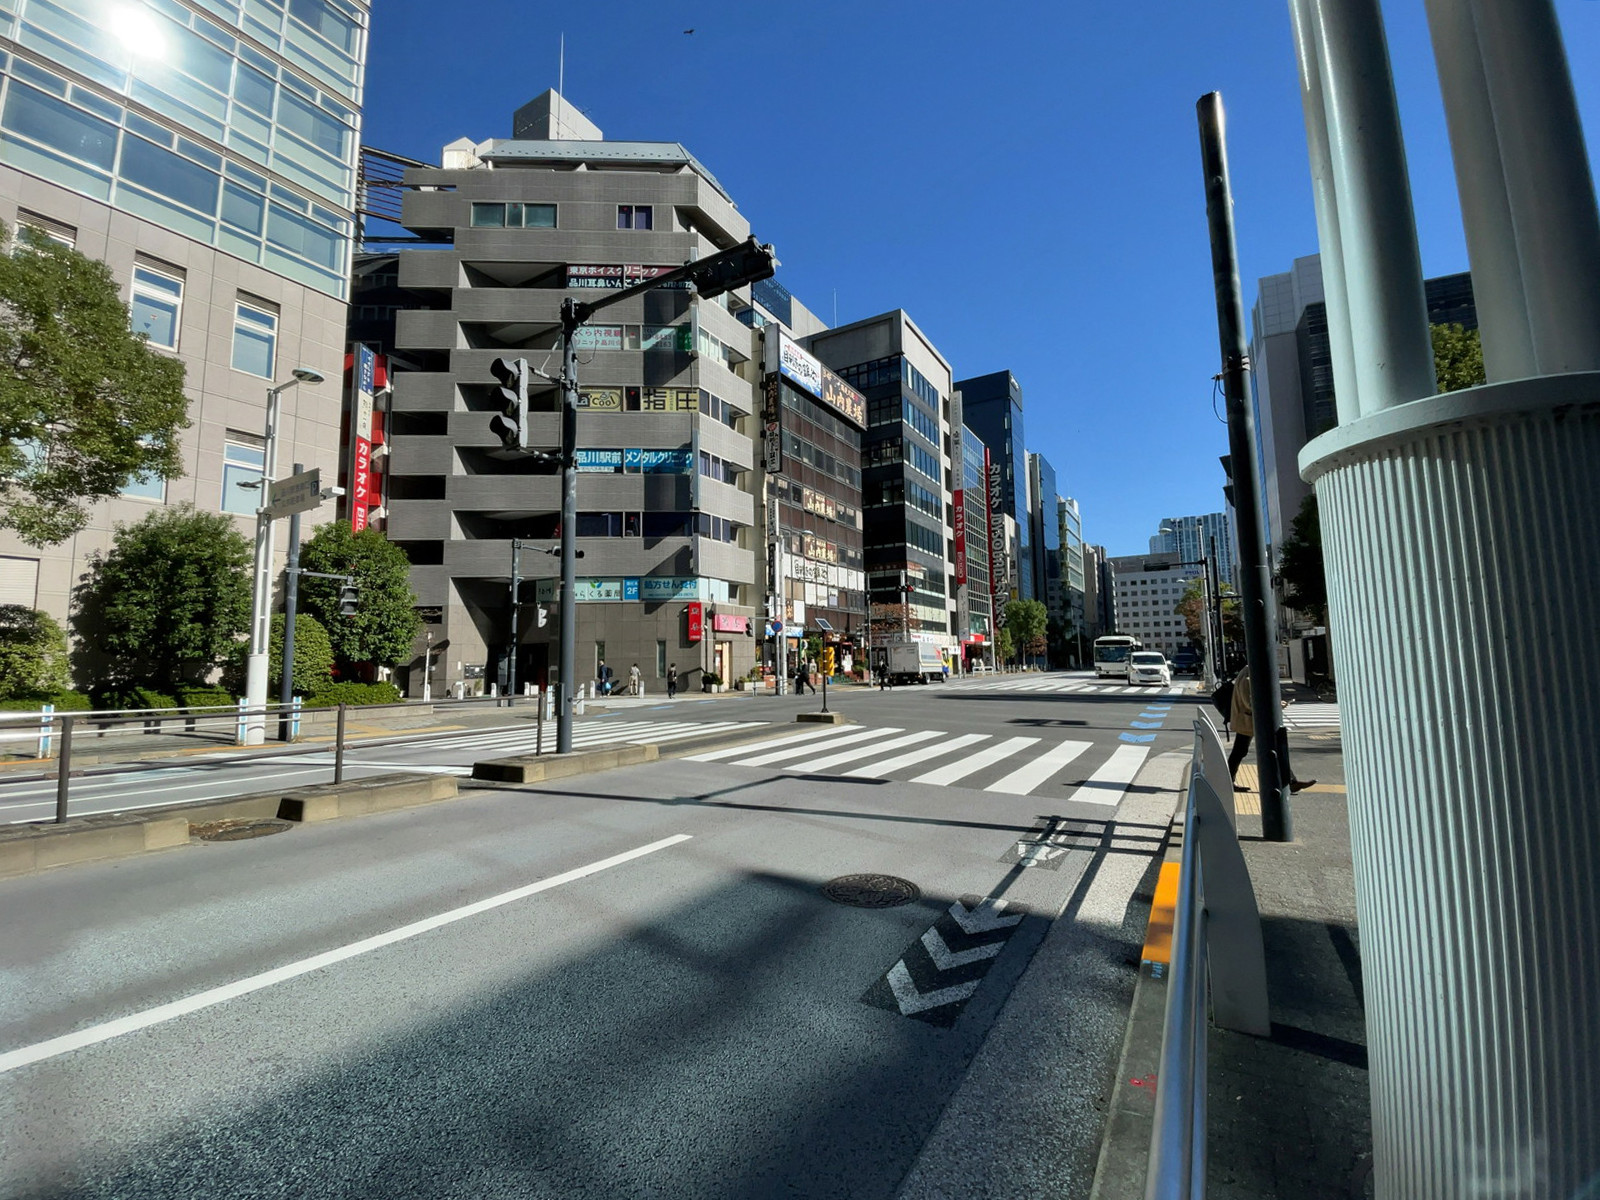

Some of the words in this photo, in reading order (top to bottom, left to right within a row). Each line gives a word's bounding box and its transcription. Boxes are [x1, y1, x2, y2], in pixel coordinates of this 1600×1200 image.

[643, 388, 697, 411] 指圧
[356, 442, 368, 498] カラオケ
[990, 464, 1003, 508] カラオケ
[956, 505, 964, 538] カラオケ
